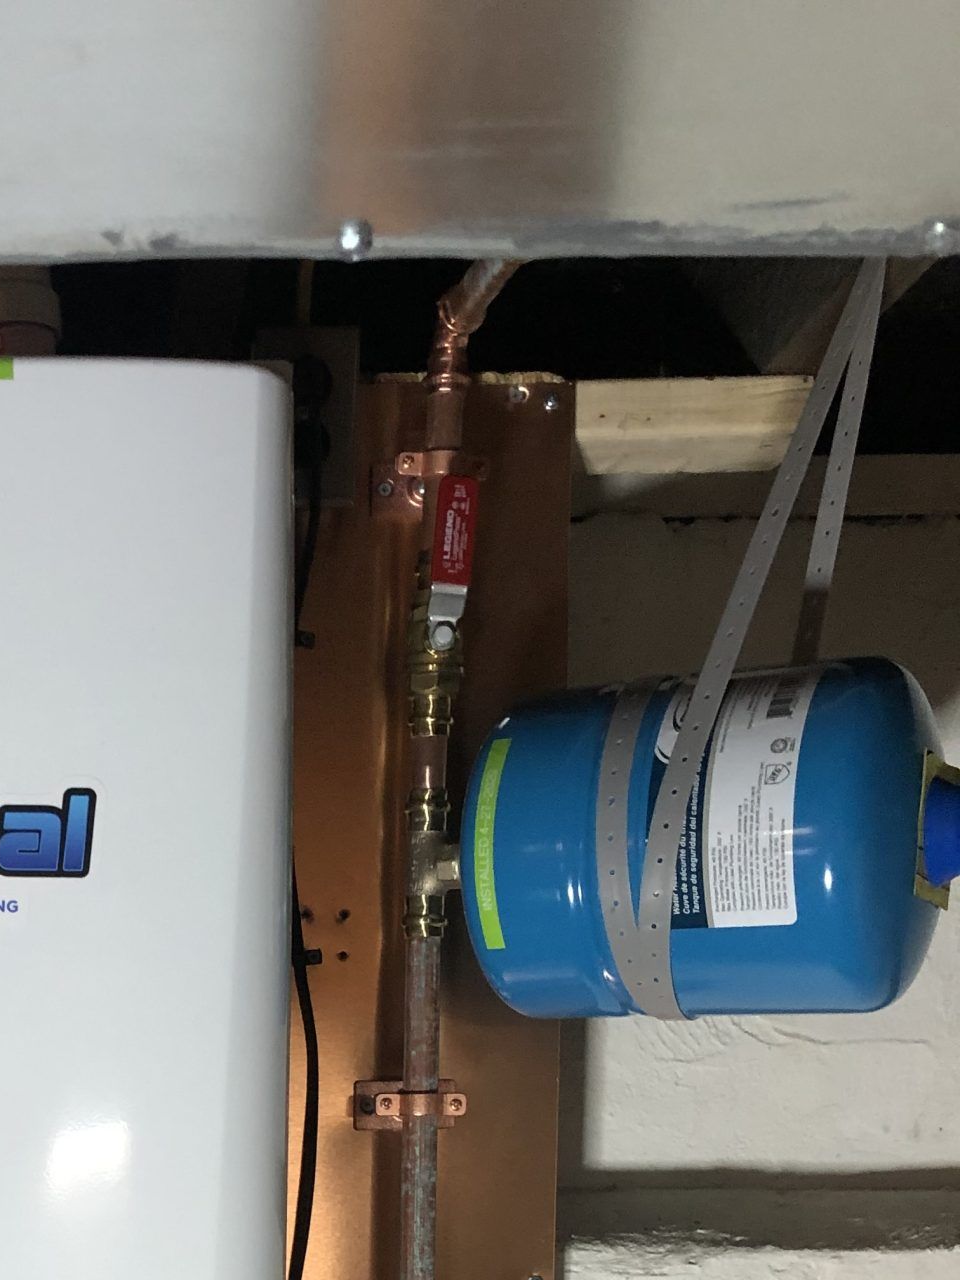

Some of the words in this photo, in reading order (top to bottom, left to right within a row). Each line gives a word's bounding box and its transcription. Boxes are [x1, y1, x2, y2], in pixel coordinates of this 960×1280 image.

[442, 509, 455, 560] LEGEND
[689, 817, 697, 830] del
[680, 850, 689, 881] sécurité
[689, 838, 699, 872] seguridad
[478, 835, 493, 911] INSTALLED
[691, 873, 698, 883] de
[681, 882, 689, 894] de
[672, 890, 681, 915] Water
[682, 895, 690, 915] Cuve
[692, 889, 701, 913] Tanque
